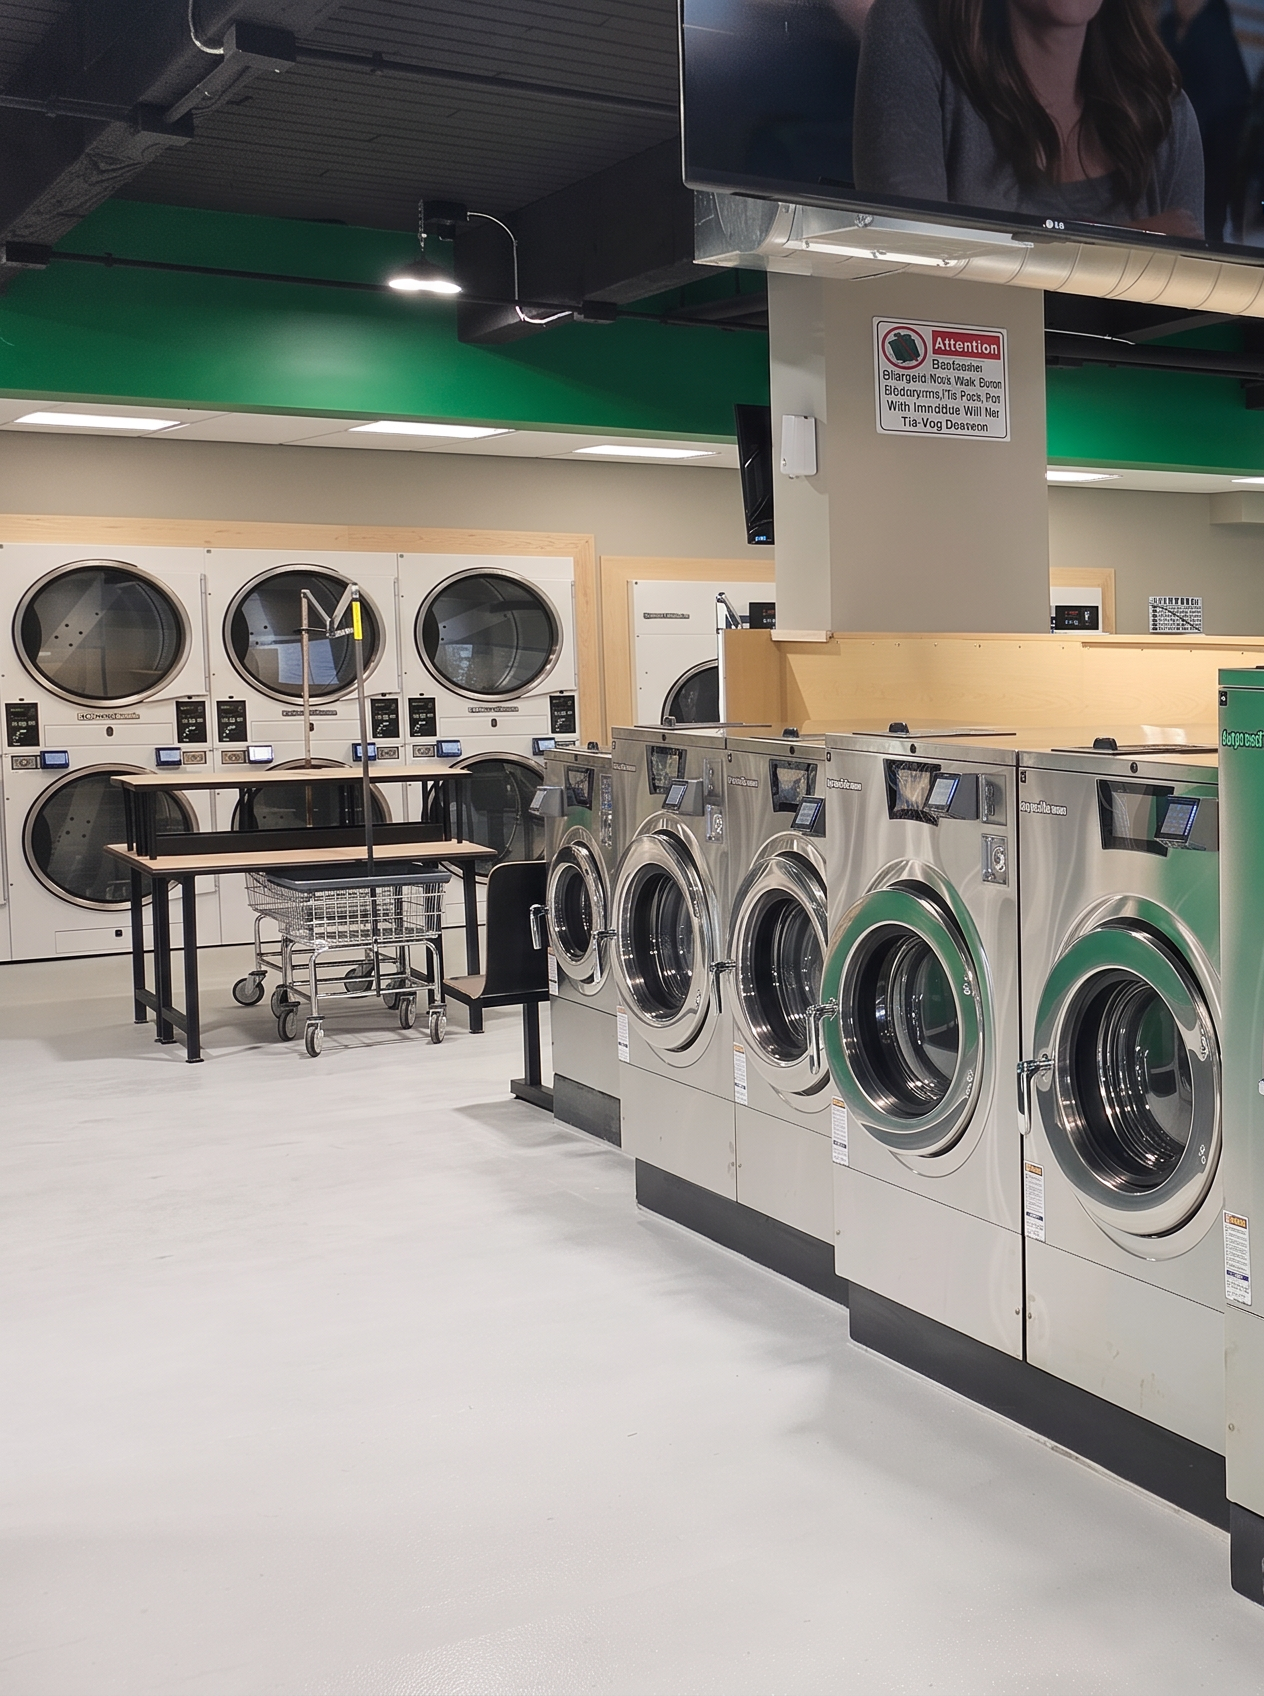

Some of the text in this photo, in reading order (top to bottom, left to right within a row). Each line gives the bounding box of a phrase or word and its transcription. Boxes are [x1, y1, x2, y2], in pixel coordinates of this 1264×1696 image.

[935, 337, 998, 354] Attention
[886, 400, 911, 413] With
[963, 405, 982, 418] Will
